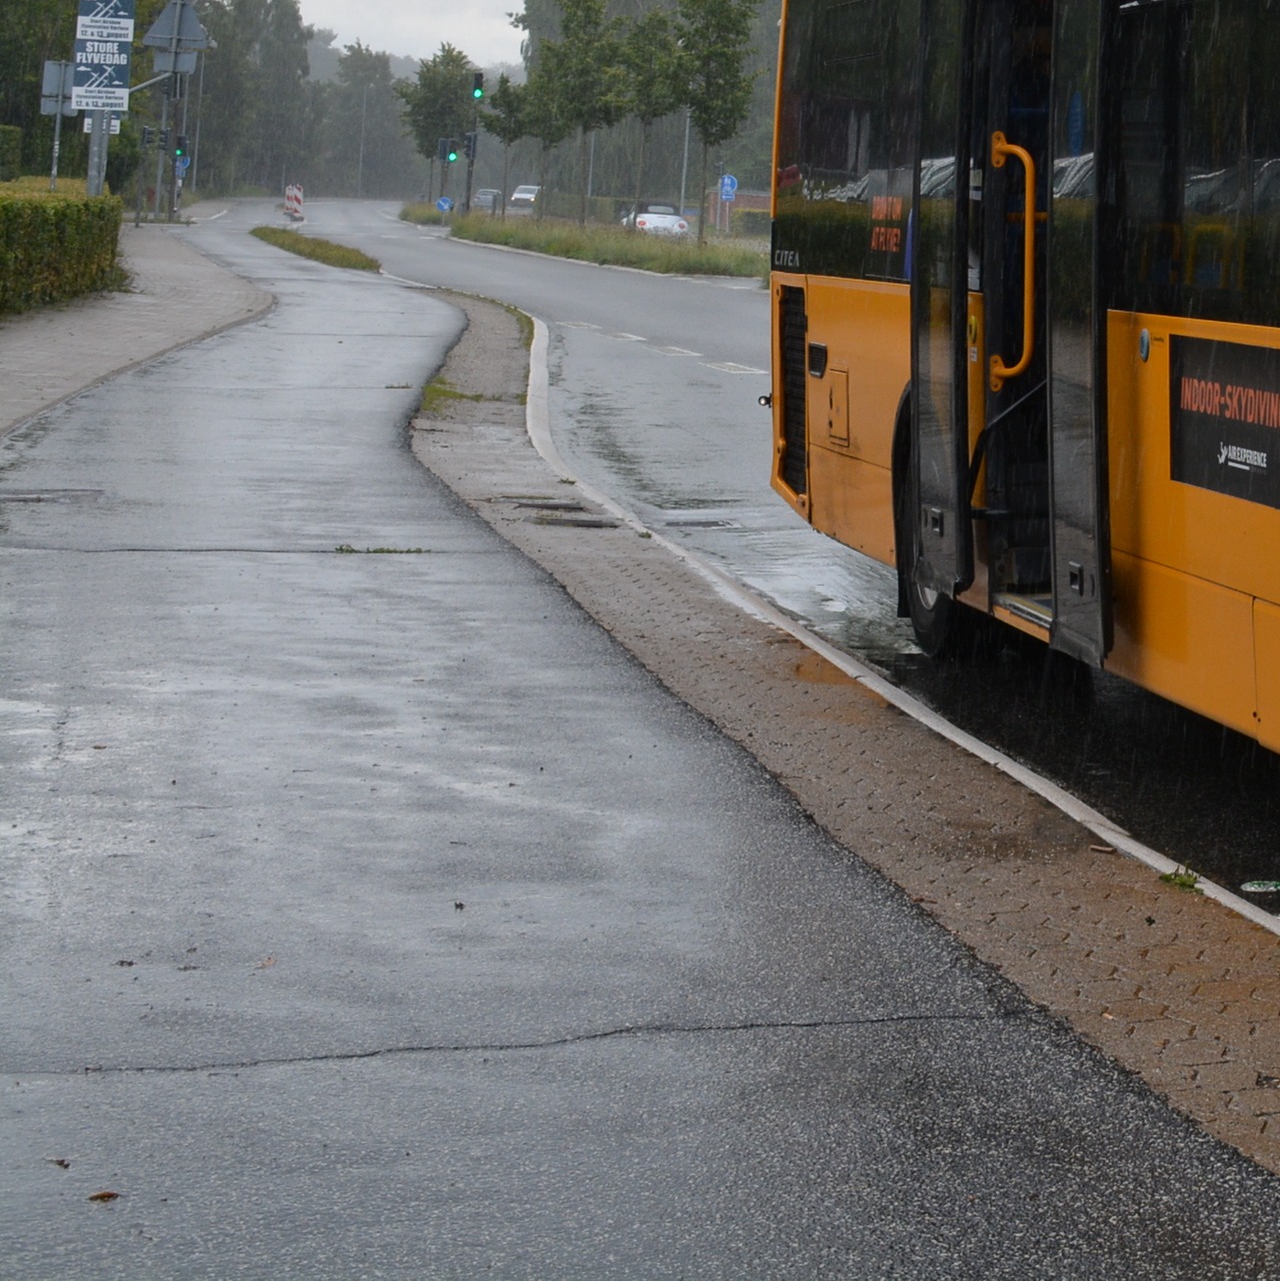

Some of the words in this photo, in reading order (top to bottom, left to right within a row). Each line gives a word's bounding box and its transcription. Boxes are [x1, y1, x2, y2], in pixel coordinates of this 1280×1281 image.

[86, 41, 120, 53] STORE
[76, 52, 128, 65] FLYVEDAG
[774, 250, 800, 267] CITEA
